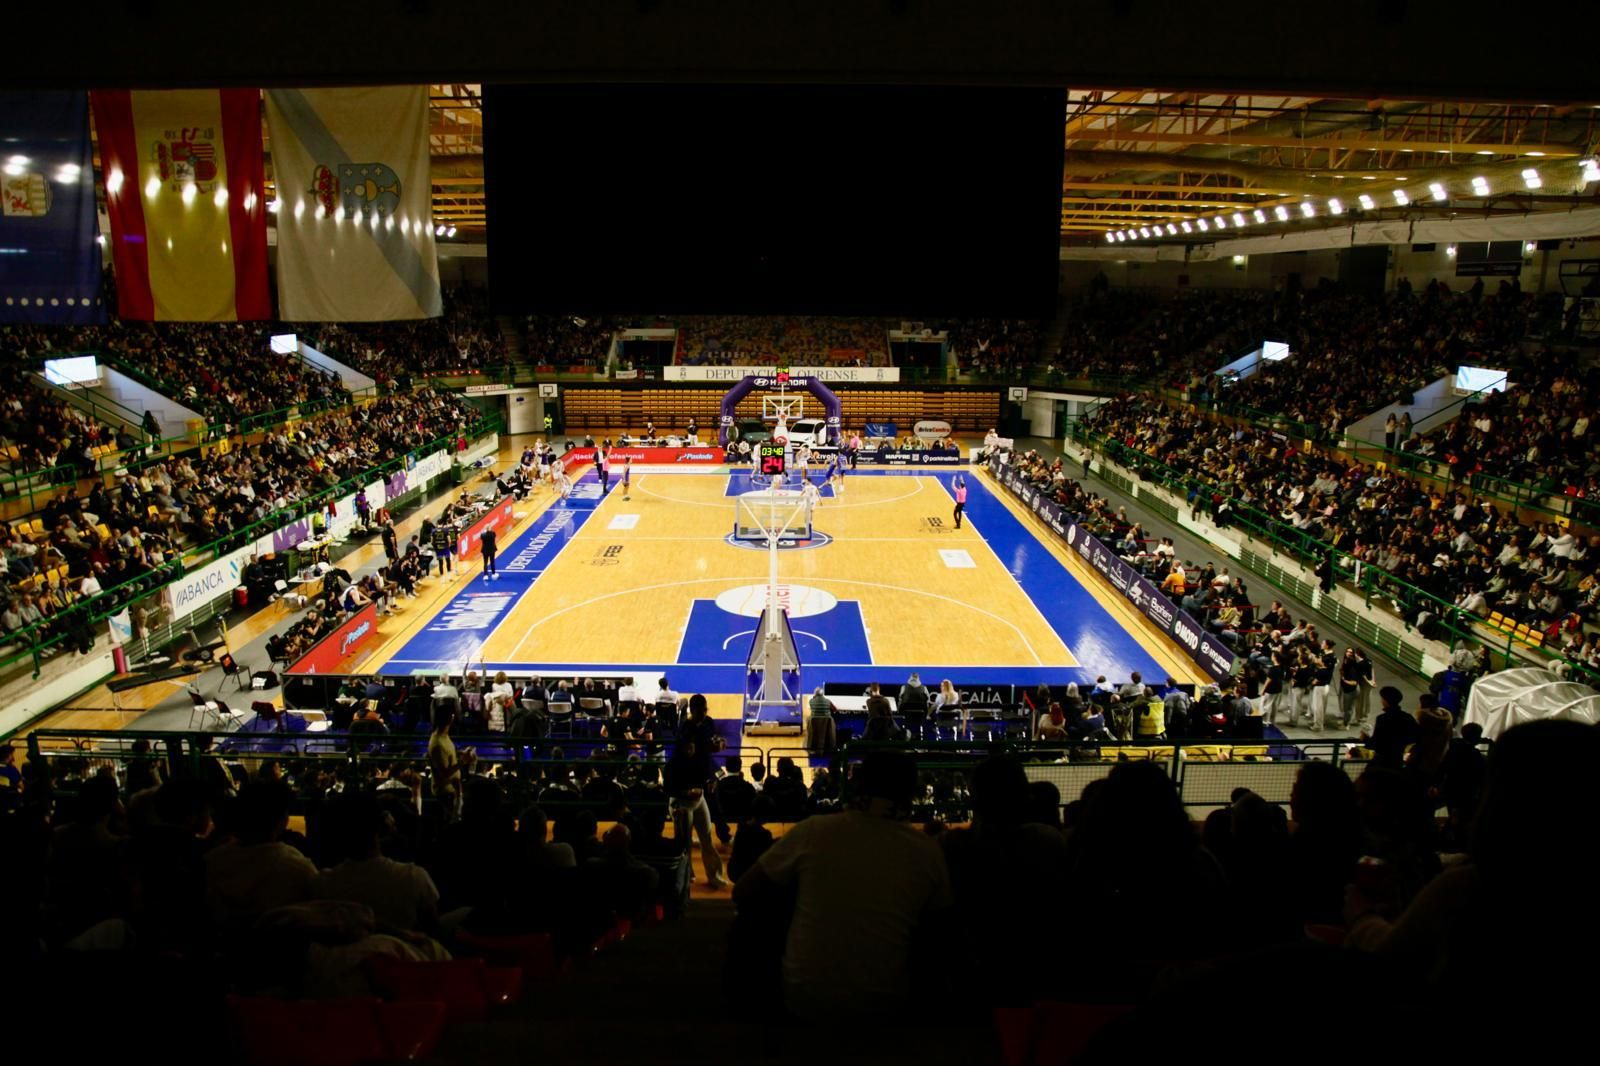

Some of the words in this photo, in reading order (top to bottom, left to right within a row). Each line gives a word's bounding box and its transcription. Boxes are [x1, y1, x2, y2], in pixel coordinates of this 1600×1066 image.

[797, 370, 858, 381] OURENSE
[762, 447, 783, 456] 03:48
[763, 457, 783, 473] 24
[179, 571, 224, 606] ABANCA
